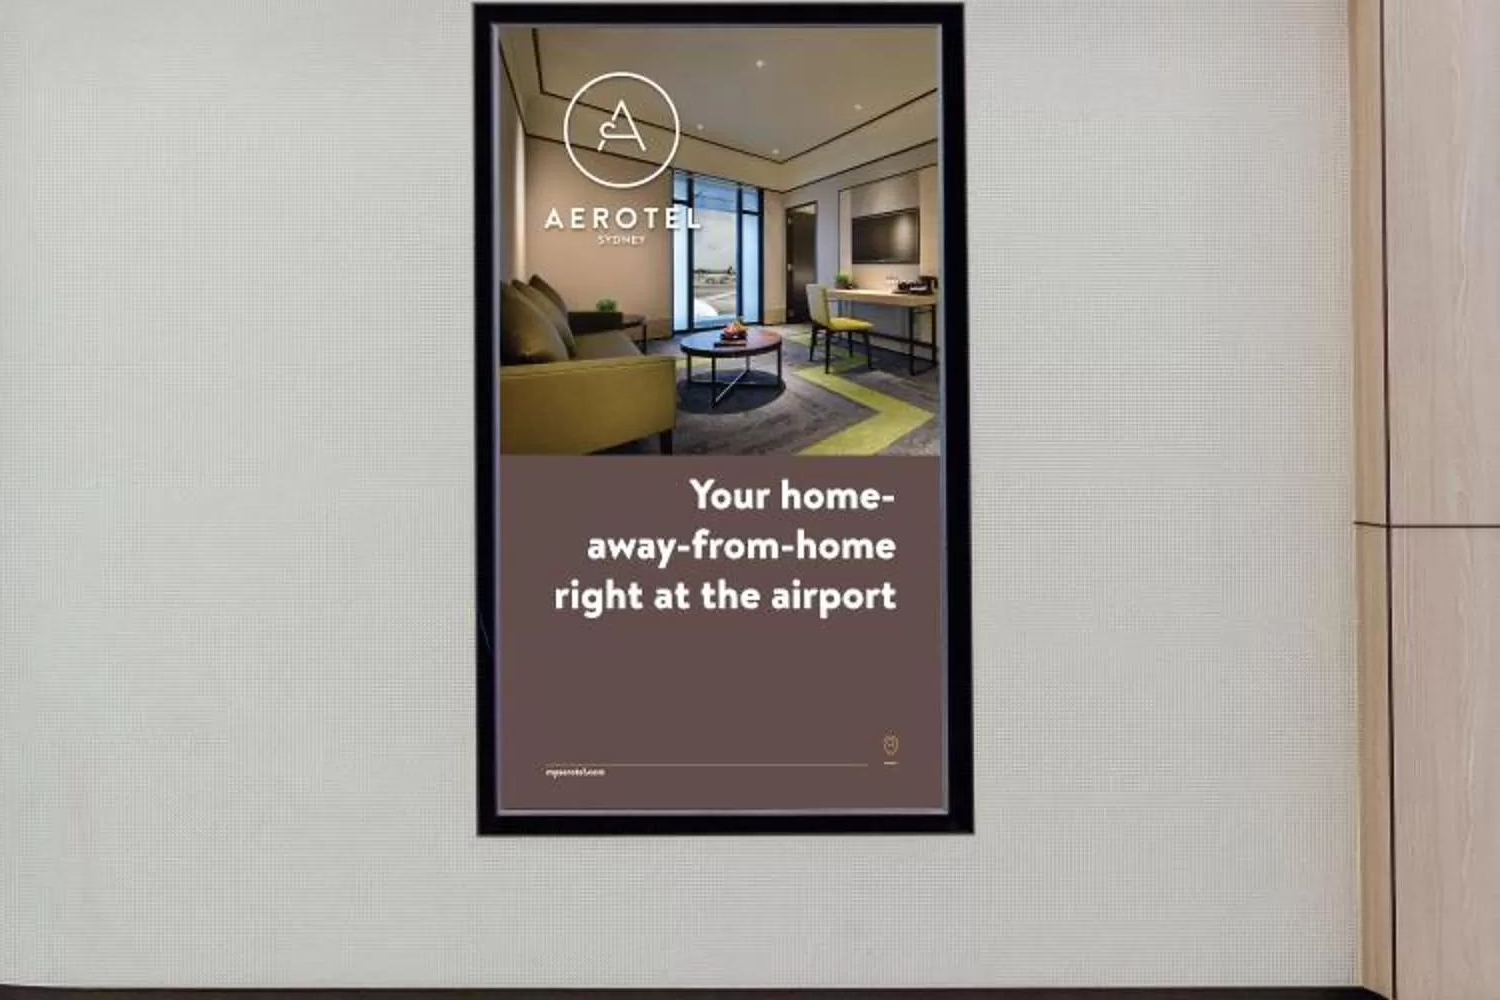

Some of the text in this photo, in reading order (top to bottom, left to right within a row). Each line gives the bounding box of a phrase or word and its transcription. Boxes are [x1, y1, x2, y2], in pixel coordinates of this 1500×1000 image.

[544, 207, 701, 230] AEROTEL
[597, 234, 646, 245] SYDNEY
[689, 478, 895, 510] Your home-
[587, 527, 897, 569] away-from-home
[555, 578, 897, 619] right at the airport
